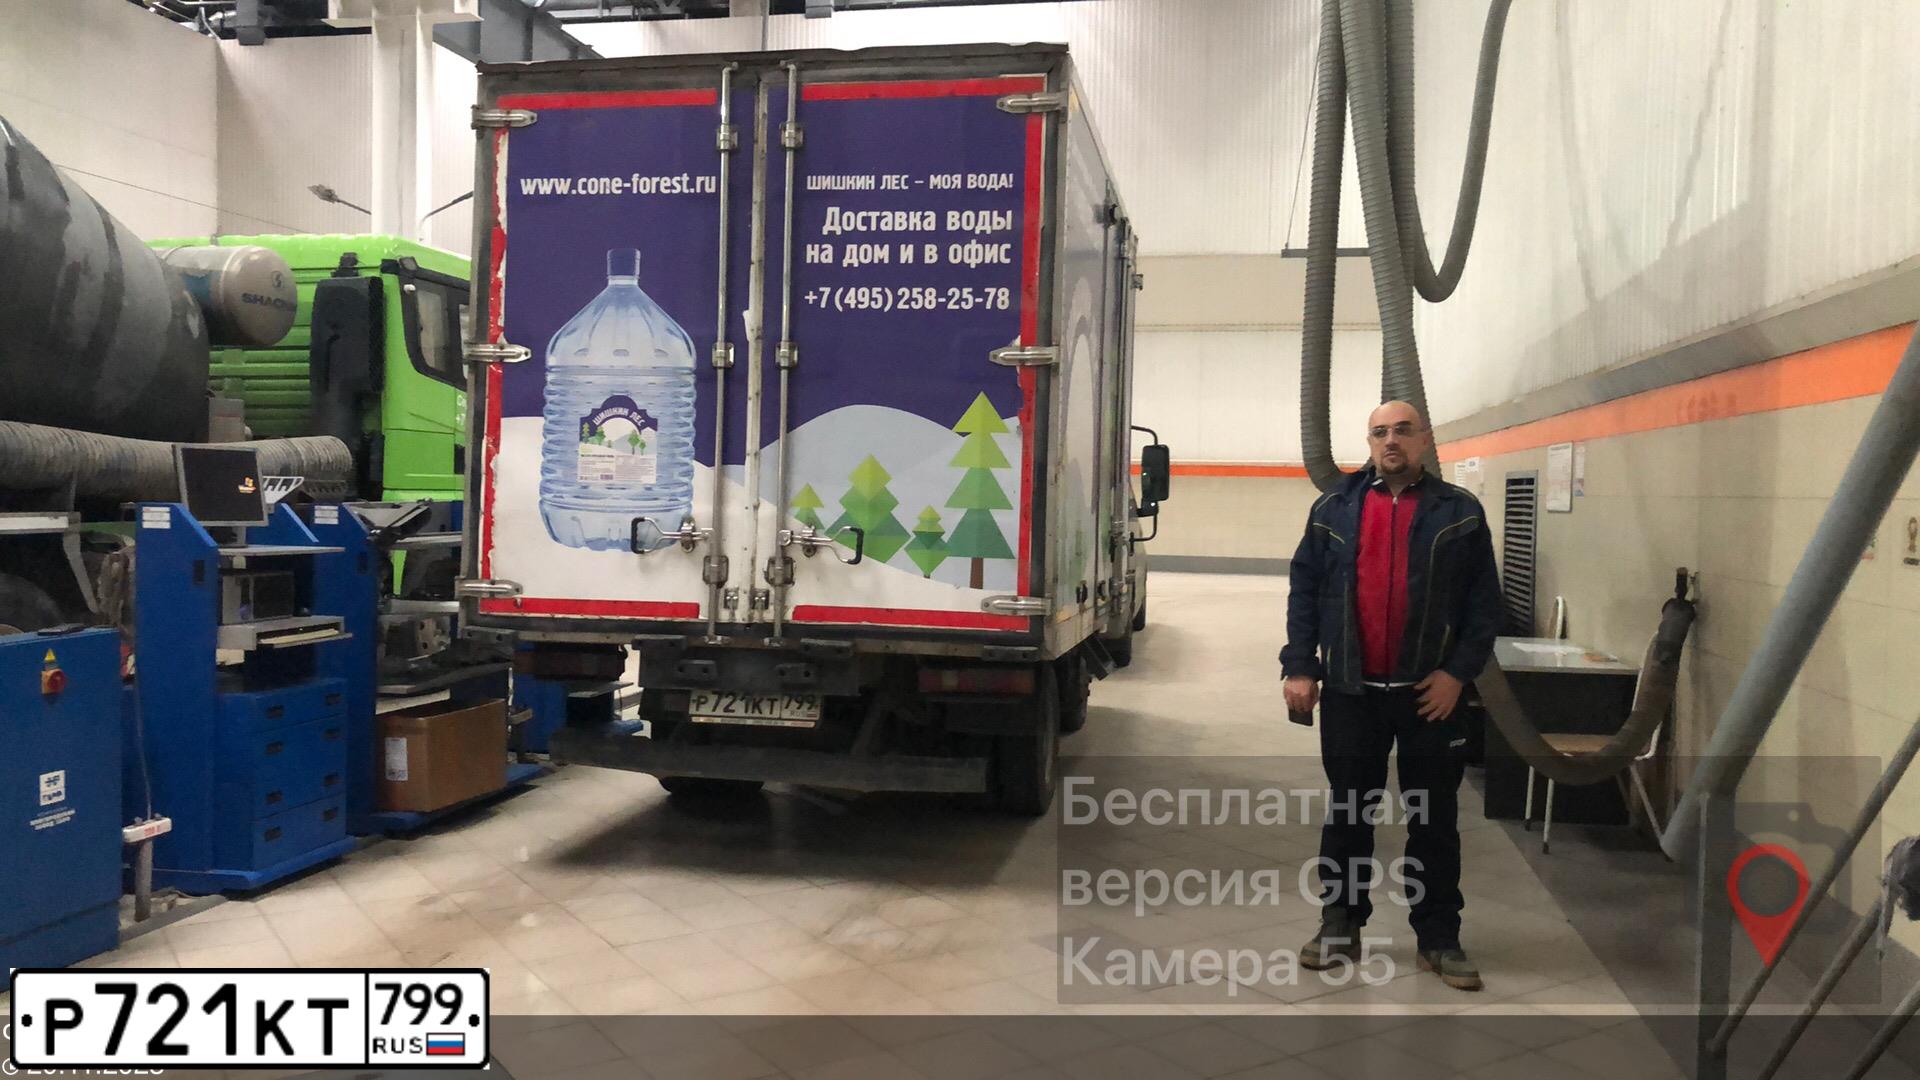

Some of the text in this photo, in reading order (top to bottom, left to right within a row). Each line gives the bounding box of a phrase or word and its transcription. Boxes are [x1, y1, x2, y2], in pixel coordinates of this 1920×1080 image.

[520, 173, 717, 195] www.cone-forest.ru
[806, 175, 876, 191] ШИШКИН
[879, 174, 910, 190] ЛЕС
[929, 174, 962, 190] МОЯ
[966, 173, 1014, 191] ВОДА!
[822, 206, 1013, 236] Доставка воды
[806, 239, 1012, 269] на дом и в офис
